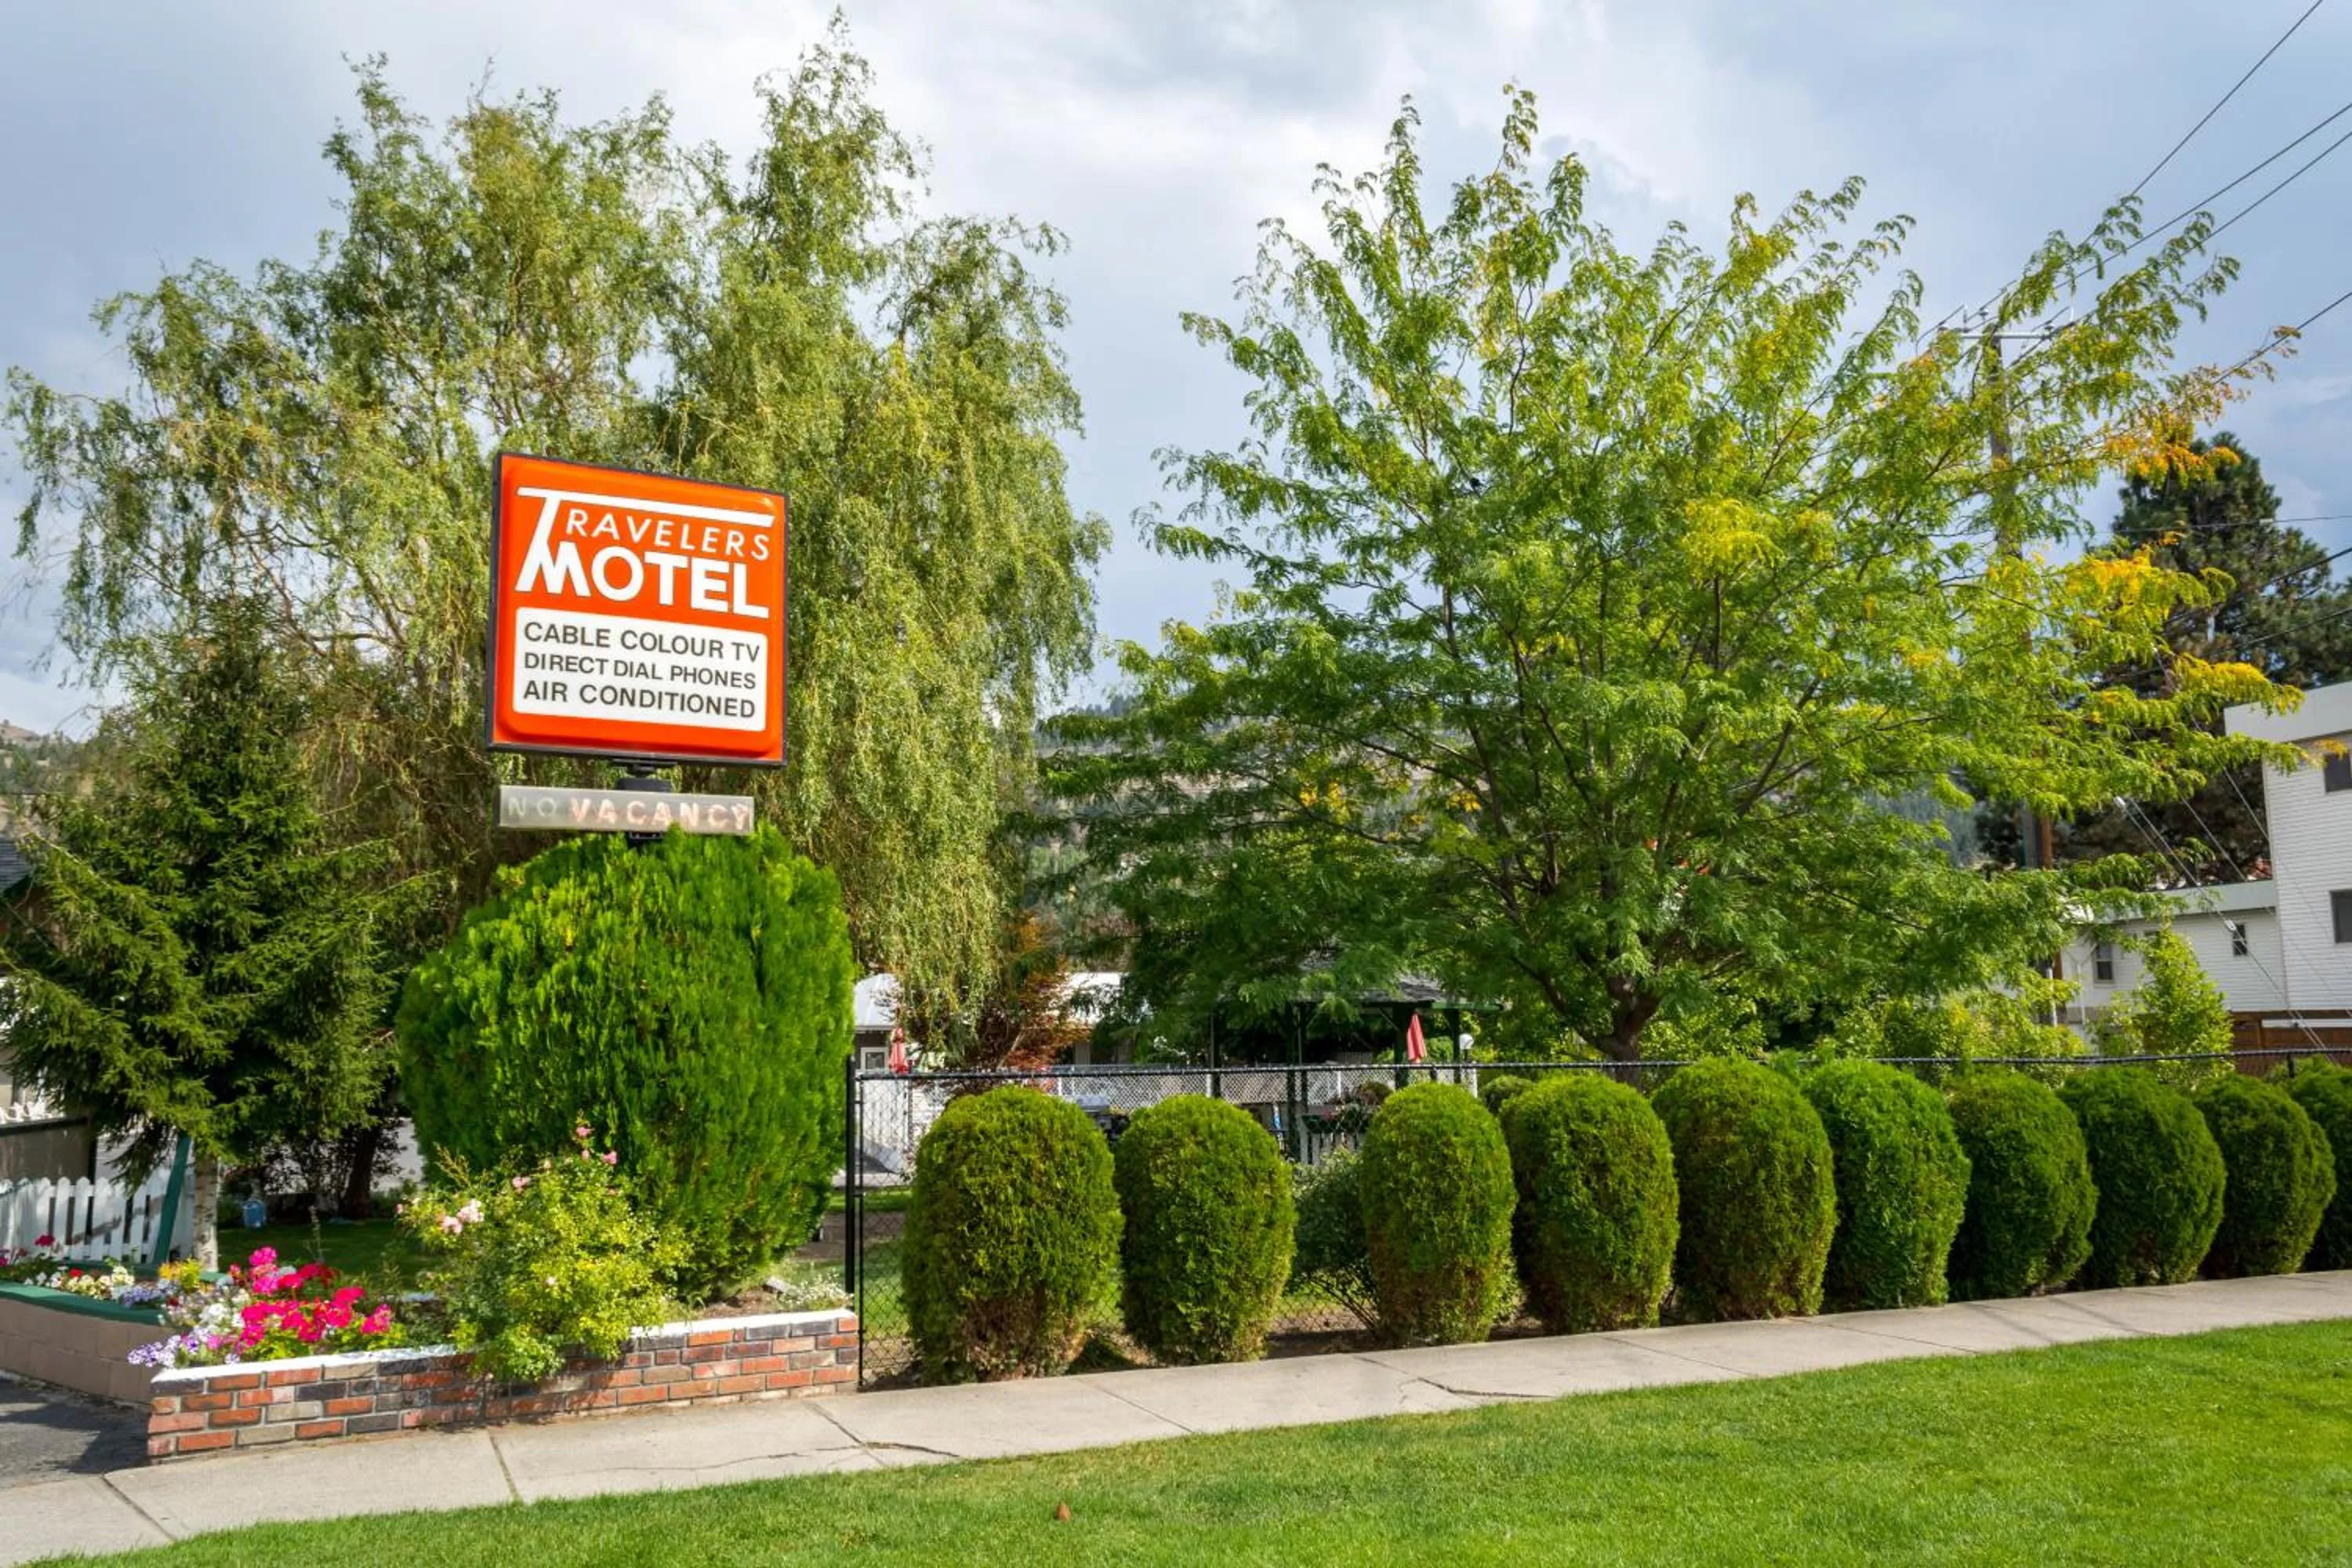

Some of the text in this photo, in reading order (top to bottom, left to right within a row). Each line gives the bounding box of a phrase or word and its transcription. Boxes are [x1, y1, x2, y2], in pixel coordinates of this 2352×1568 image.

[517, 487, 775, 561] TRAVELERS
[515, 540, 768, 619] MOTEL
[524, 622, 760, 662] CABLE COLOUR TV
[524, 652, 756, 689] DIRECT DIAL PHONES
[524, 681, 754, 718] AIR CONDITIONED
[509, 796, 753, 831] NO VACANCY
